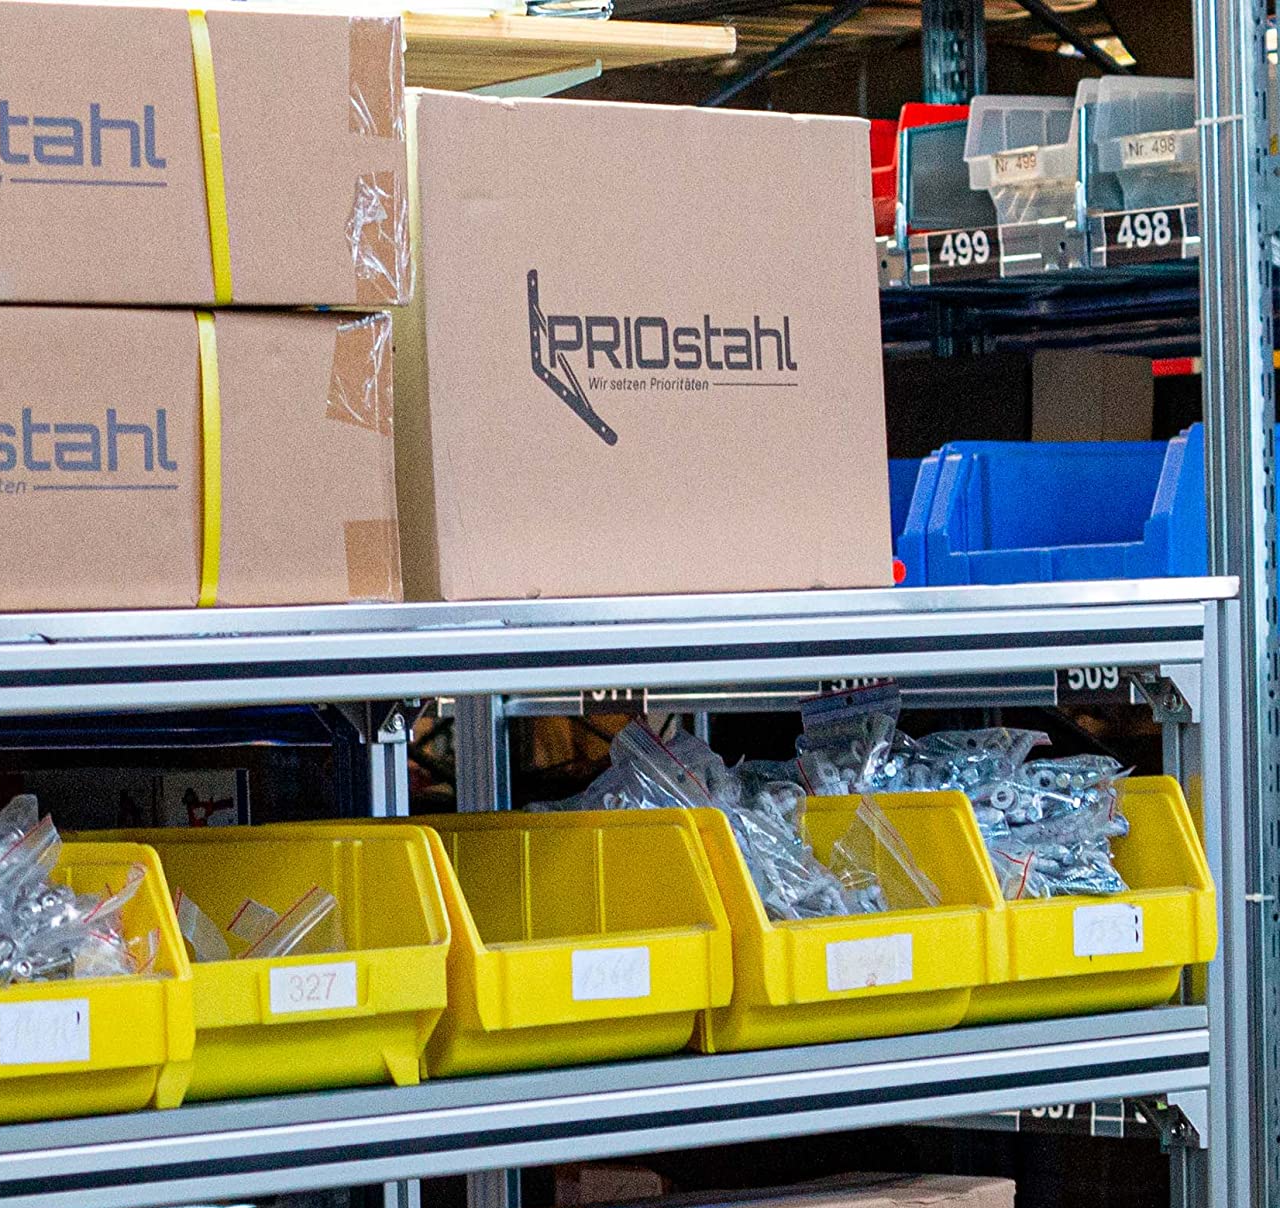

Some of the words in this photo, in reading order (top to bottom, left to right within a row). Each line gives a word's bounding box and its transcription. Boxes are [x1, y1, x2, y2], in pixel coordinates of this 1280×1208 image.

[1151, 134, 1175, 153] 498
[1015, 153, 1037, 170] 499
[1117, 211, 1172, 248] 498
[939, 231, 991, 267] 499
[548, 314, 797, 372] PRIOstahl
[588, 377, 609, 391] Wir
[610, 378, 646, 391] setzen
[650, 377, 709, 392] Prioritäten
[289, 972, 337, 1002] 327
